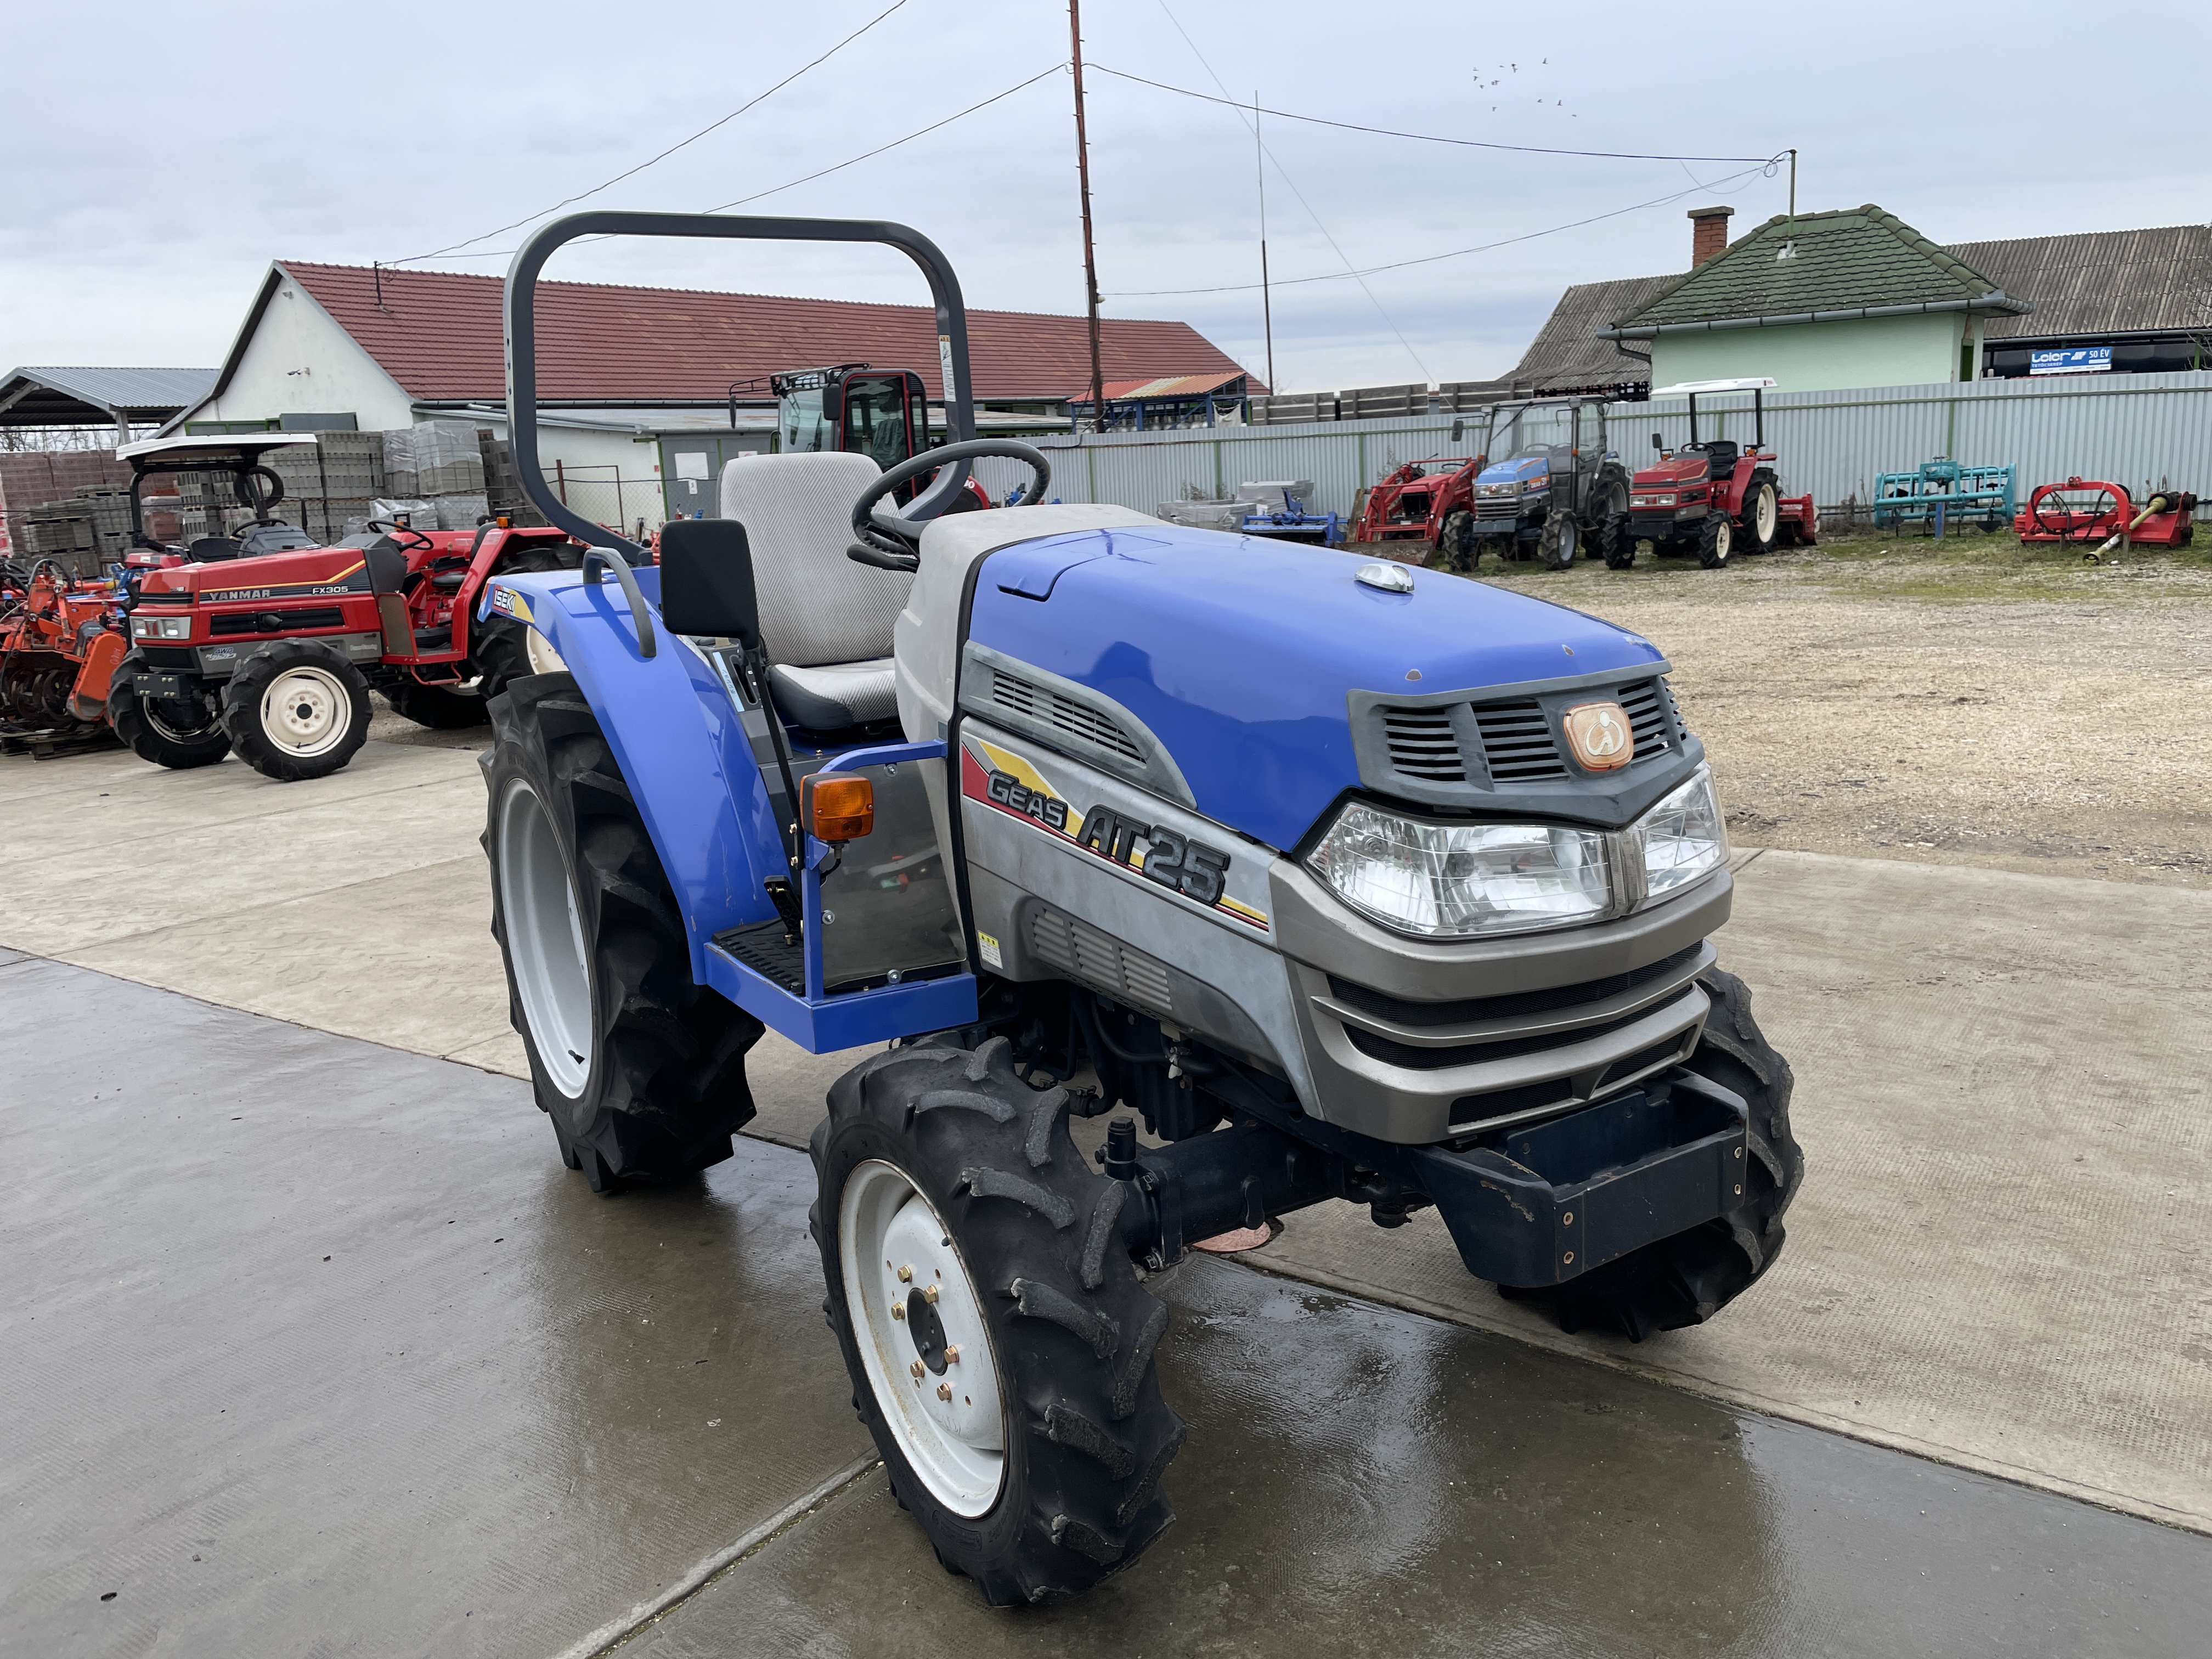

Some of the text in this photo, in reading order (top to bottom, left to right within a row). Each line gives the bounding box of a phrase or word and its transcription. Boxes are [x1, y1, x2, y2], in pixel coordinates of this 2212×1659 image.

[2032, 352, 2071, 363] Leier
[2089, 348, 2110, 358] 50 ÉV
[210, 585, 348, 601] YANMAR FX305
[494, 589, 516, 612] ISEKI
[987, 769, 1068, 831] GEAS
